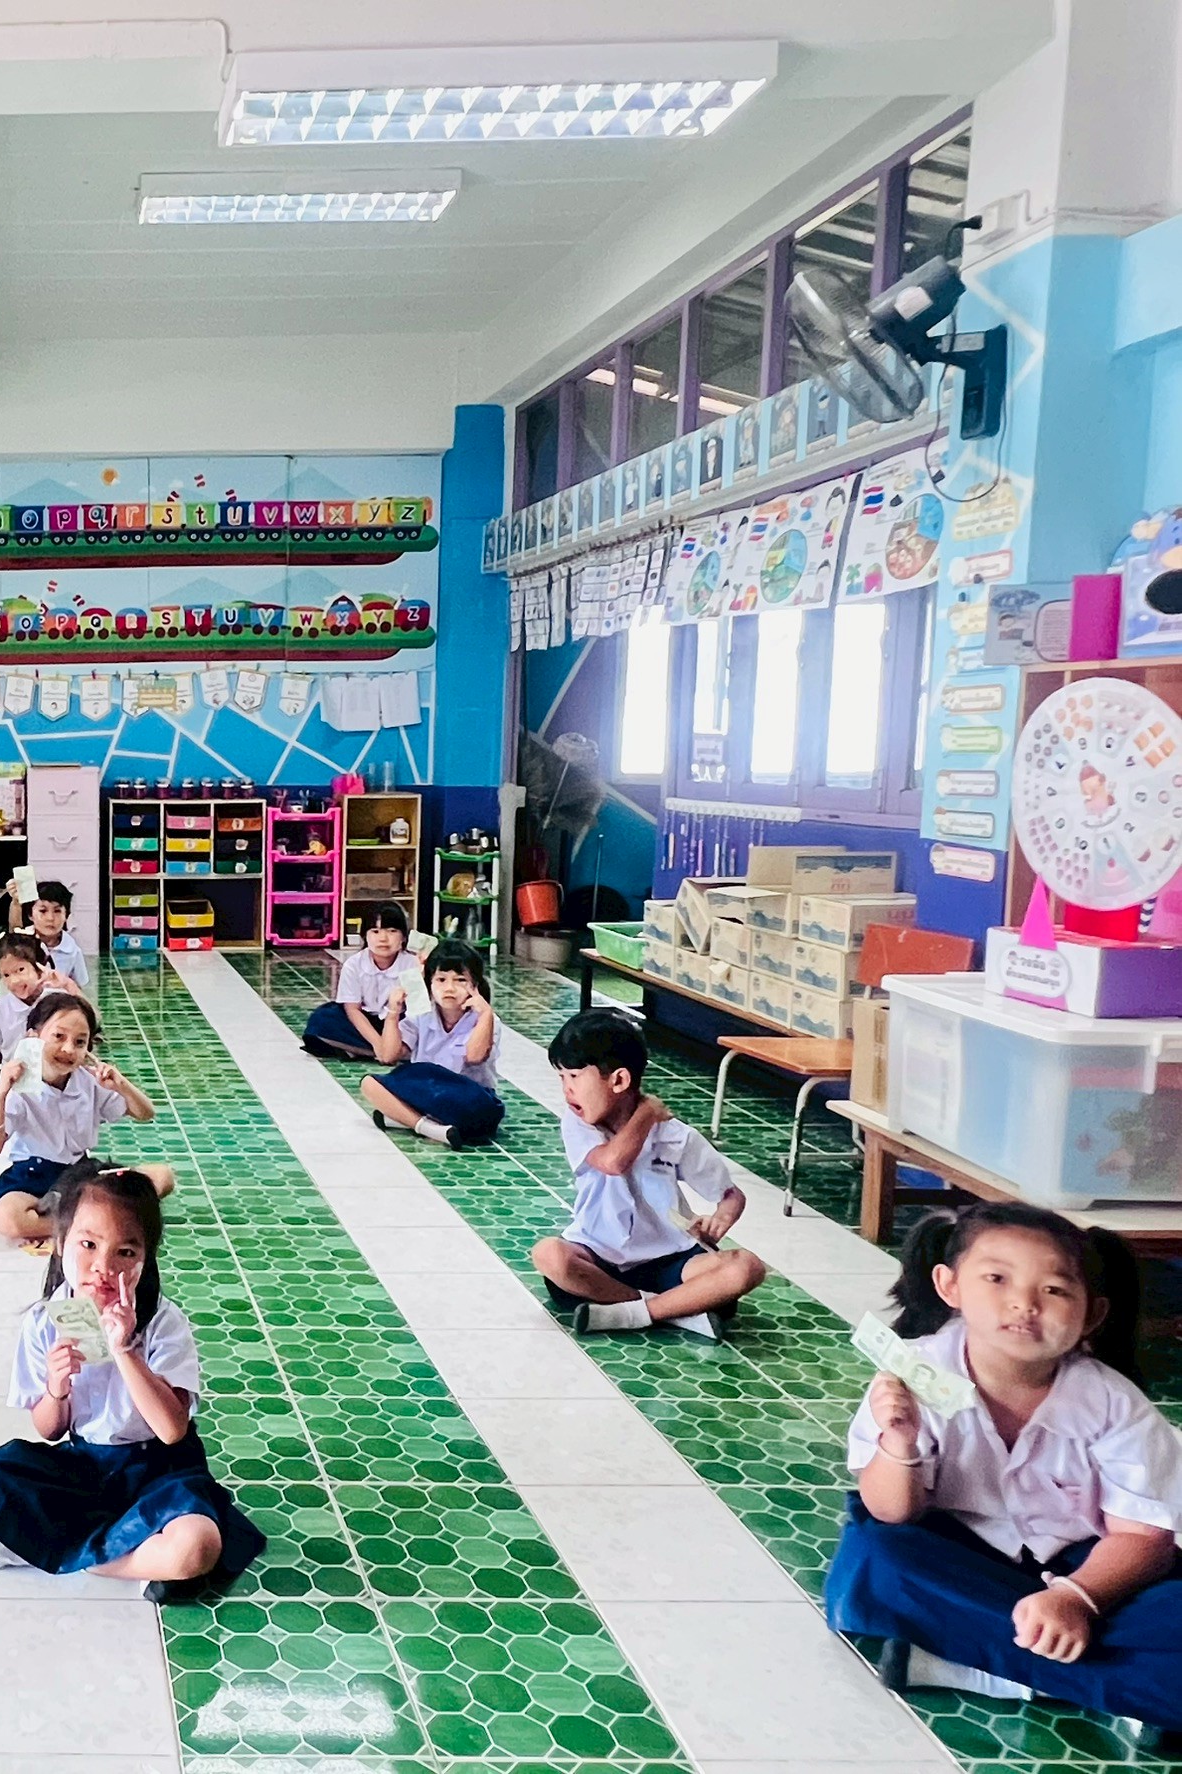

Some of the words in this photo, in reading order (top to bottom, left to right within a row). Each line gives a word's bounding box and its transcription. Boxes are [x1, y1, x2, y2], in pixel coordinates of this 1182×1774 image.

[56, 508, 71, 529] p
[88, 505, 108, 530] q
[125, 506, 139, 528] r
[195, 507, 207, 525] t
[227, 506, 242, 526] u
[369, 505, 381, 522] y
[21, 616, 31, 630] O
[56, 614, 68, 628] P
[90, 615, 102, 628] Q
[161, 612, 171, 625] S
[191, 608, 206, 626] T
[224, 608, 238, 624] U
[260, 608, 276, 626] V
[300, 613, 313, 626] W
[336, 611, 349, 626] X
[374, 611, 384, 624] Y
[407, 608, 420, 621] Z
